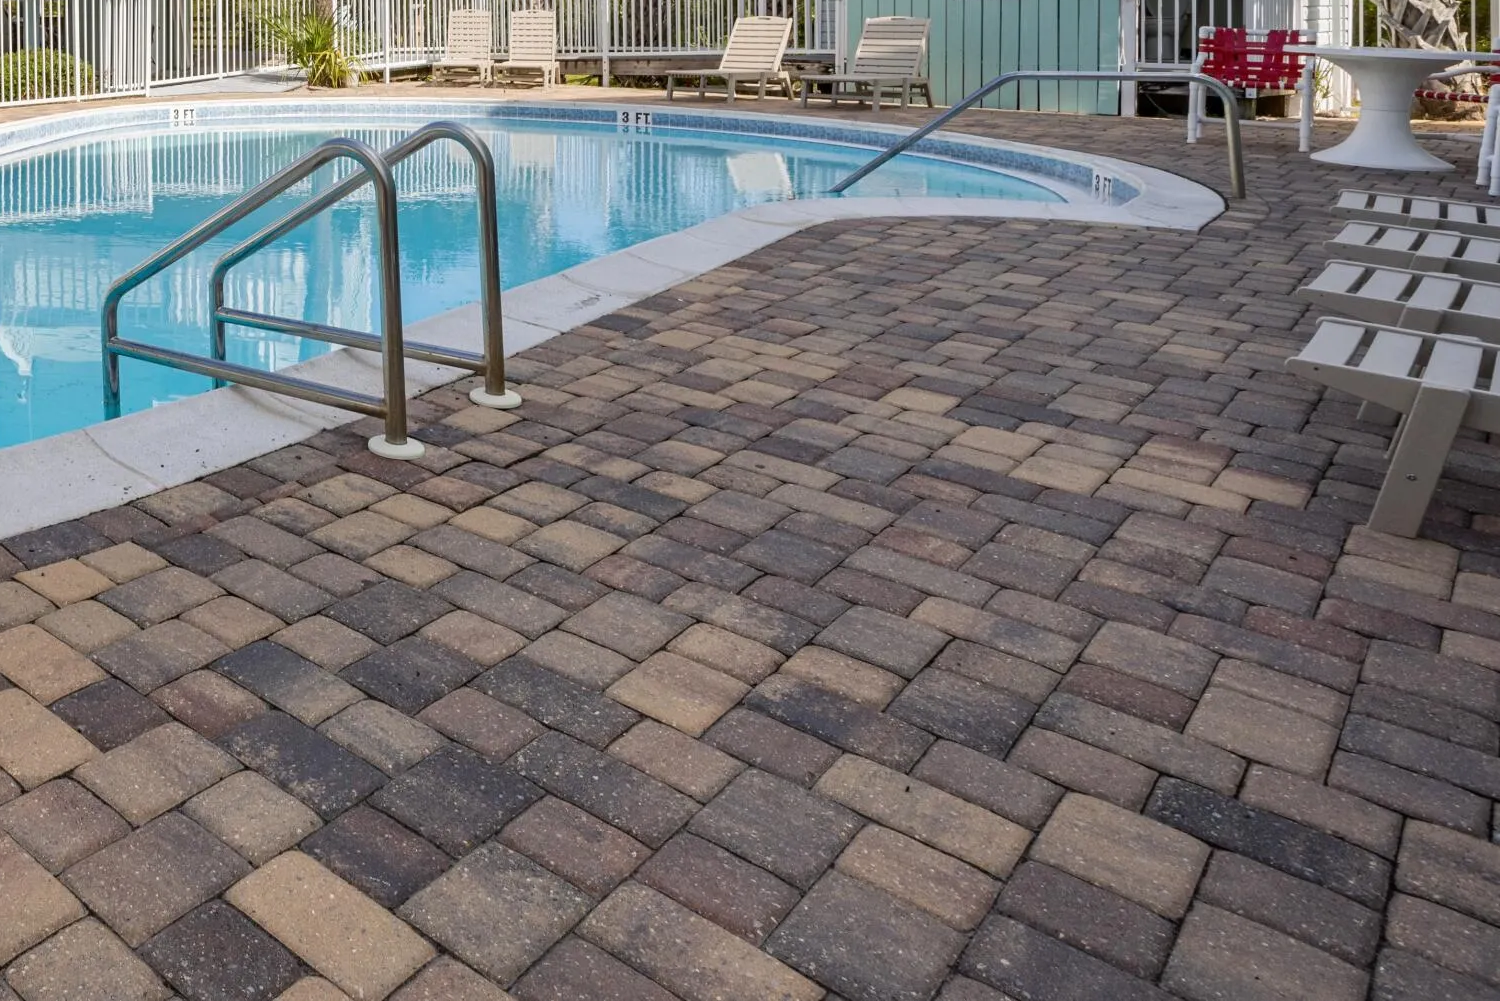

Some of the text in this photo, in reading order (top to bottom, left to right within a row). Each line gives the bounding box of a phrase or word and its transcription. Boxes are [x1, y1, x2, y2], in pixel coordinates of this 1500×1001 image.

[174, 109, 194, 120] 3 FT
[622, 112, 629, 123] 3
[1094, 174, 1112, 195] 3 FT
